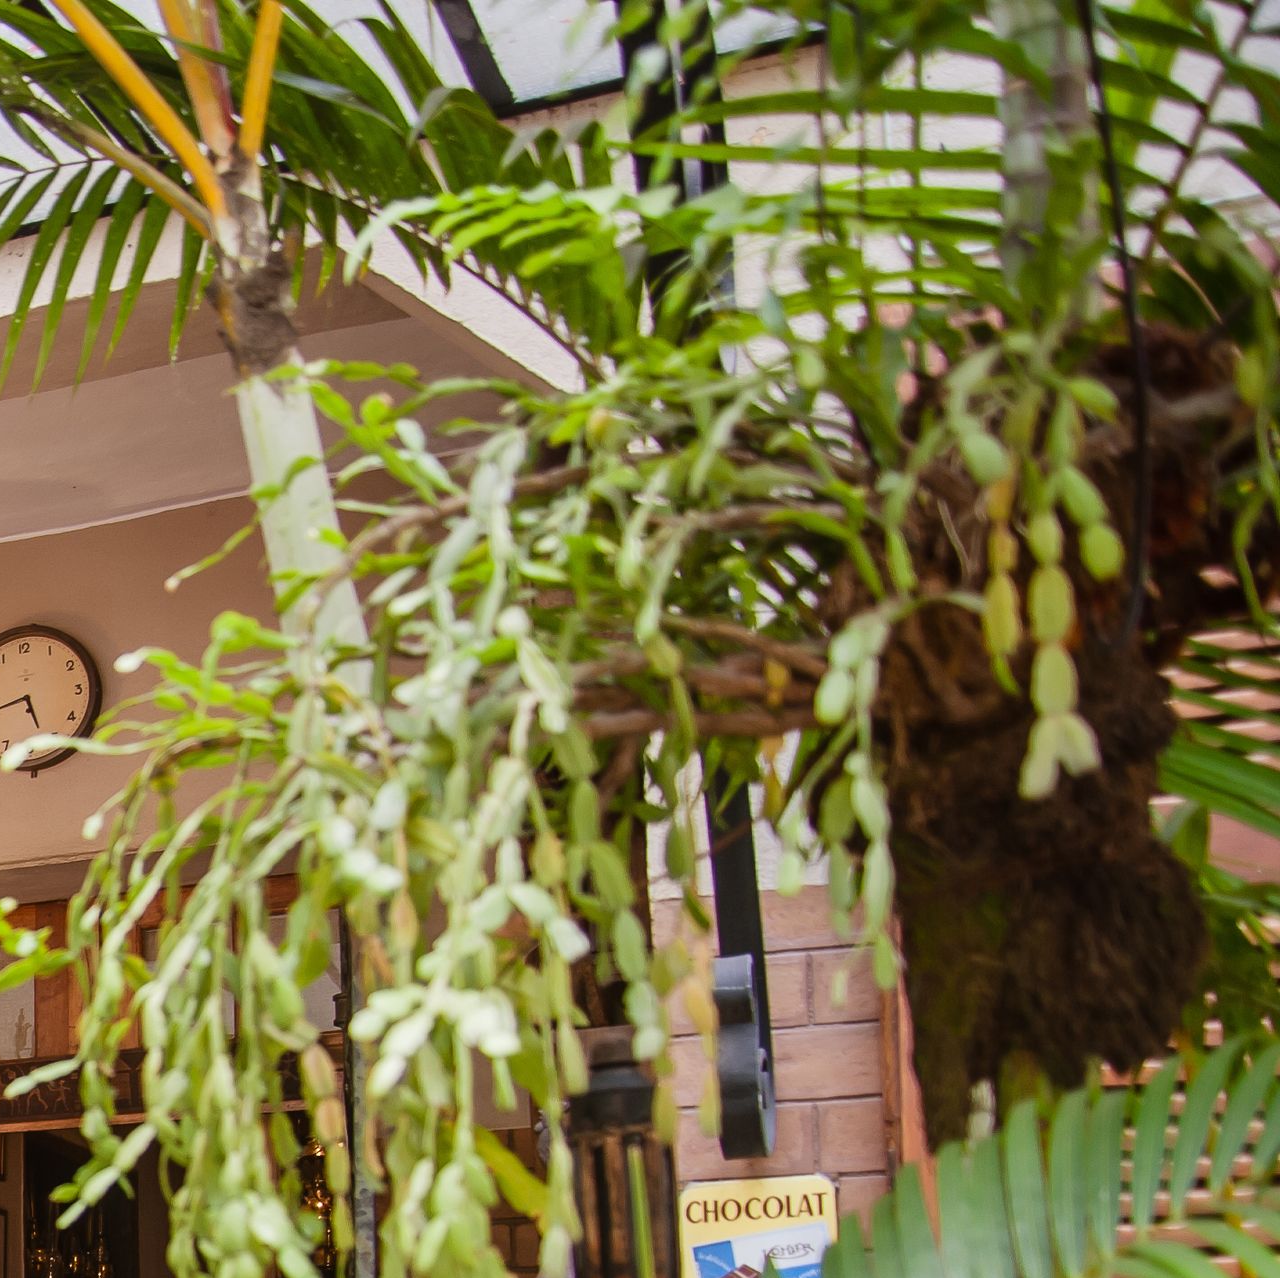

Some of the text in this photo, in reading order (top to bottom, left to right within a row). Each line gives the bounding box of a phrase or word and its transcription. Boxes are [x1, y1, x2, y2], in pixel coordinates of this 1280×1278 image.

[18, 642, 30, 654] 12
[66, 660, 75, 671] 2
[74, 684, 83, 695] 3
[67, 710, 76, 721] 4
[685, 1191, 829, 1224] CHOCOLAT
